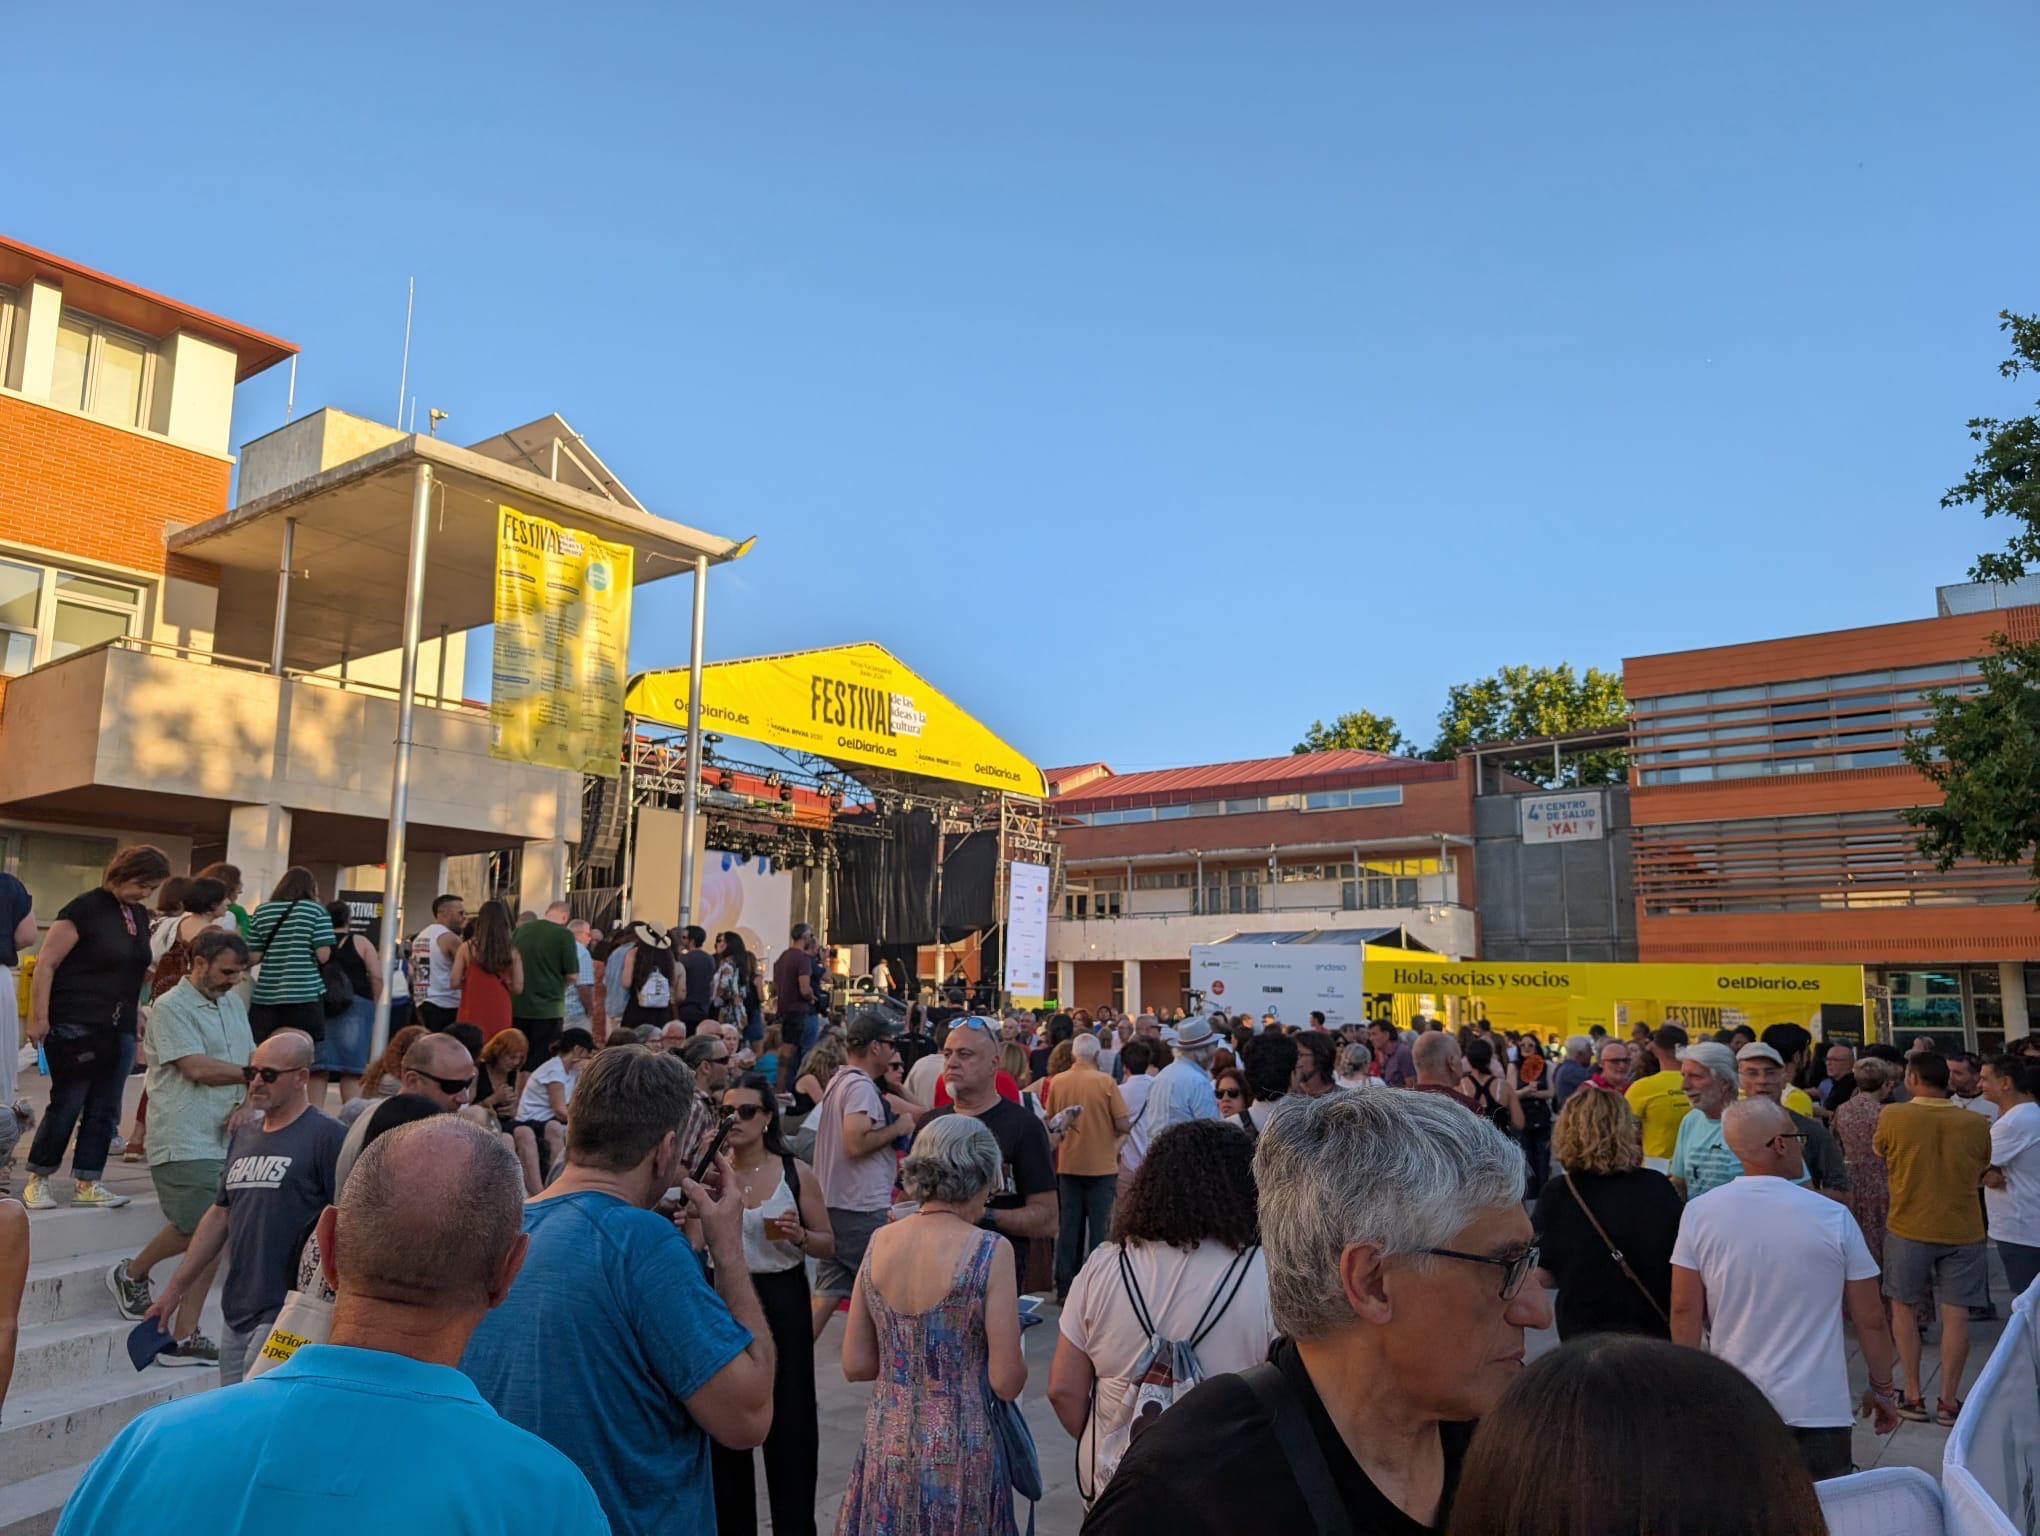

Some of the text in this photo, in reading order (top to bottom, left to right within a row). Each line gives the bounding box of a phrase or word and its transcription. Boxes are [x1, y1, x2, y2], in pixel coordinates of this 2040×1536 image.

[503, 513, 564, 556] FESTIVAL
[811, 675, 897, 737] FESTIVAL
[891, 694, 914, 708] de las
[891, 707, 911, 720] ideas
[919, 712, 927, 723] la
[891, 720, 921, 734] cultura
[1546, 801, 1586, 811] CENTRO
[1546, 809, 1596, 820] DE SALUD
[1547, 822, 1577, 838] ¡YA!
[1393, 969, 1570, 989] Hola, socias y socios
[226, 1156, 293, 1184] GIANTS
[262, 1345, 270, 1355] a
